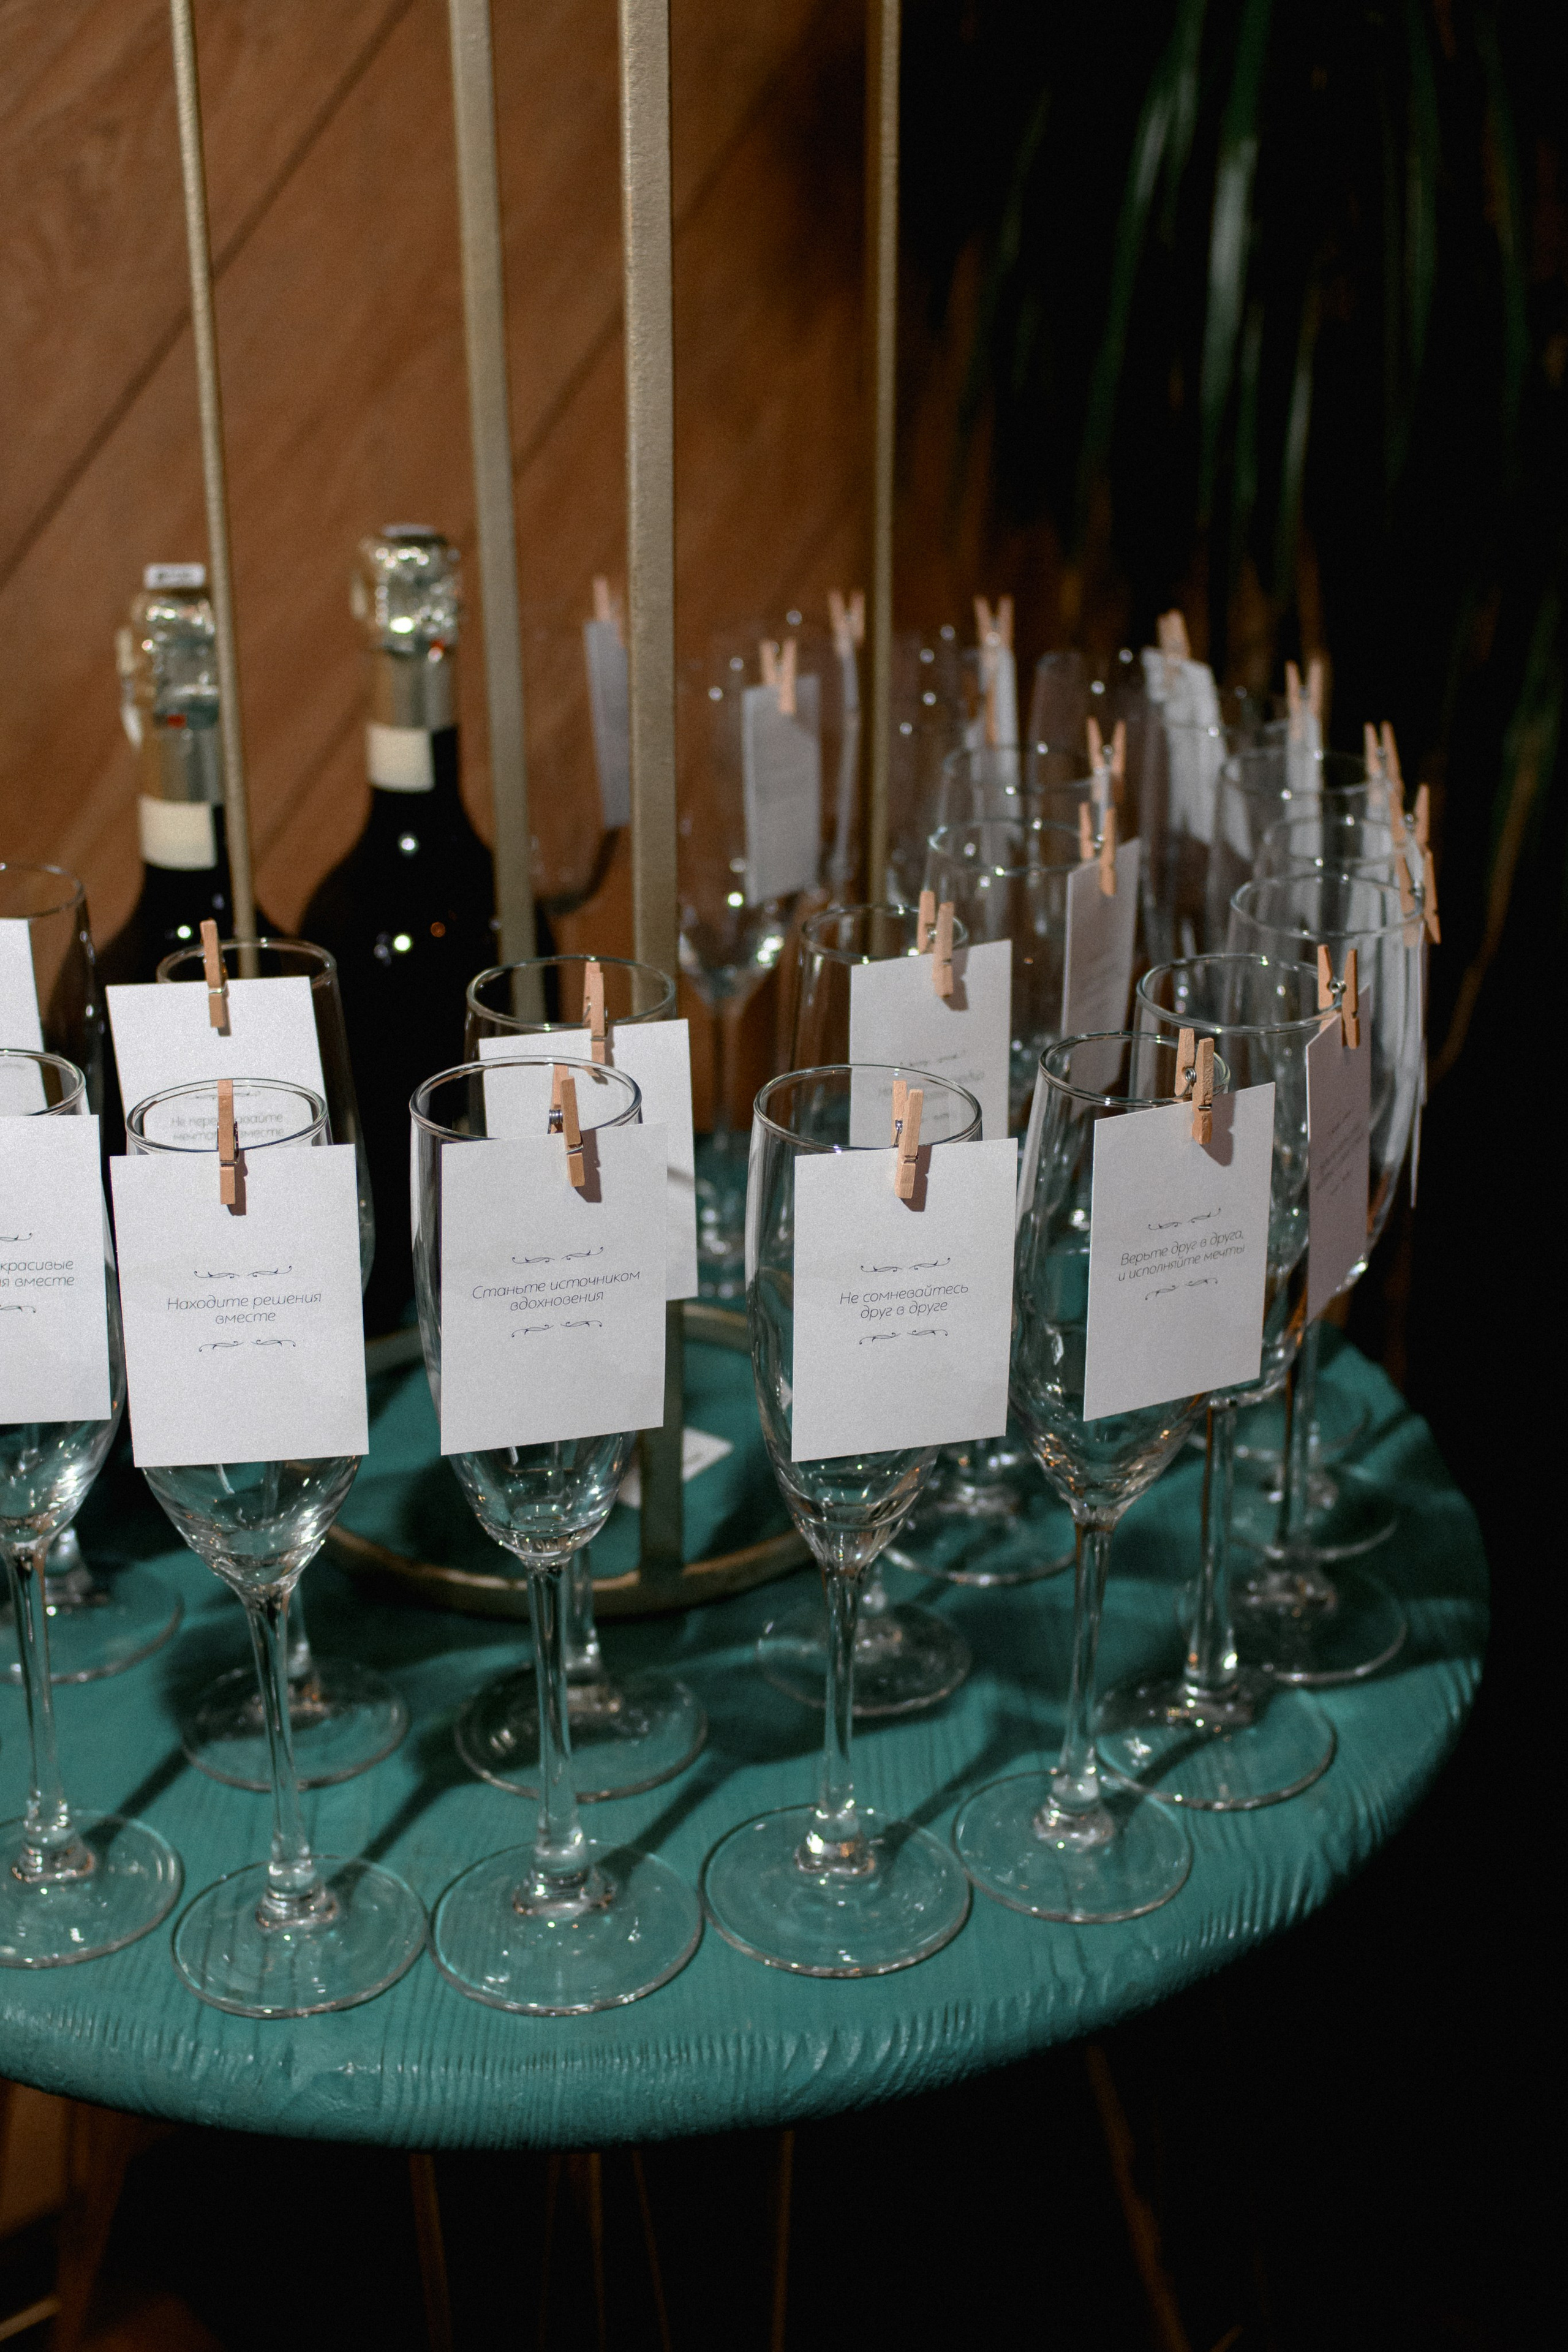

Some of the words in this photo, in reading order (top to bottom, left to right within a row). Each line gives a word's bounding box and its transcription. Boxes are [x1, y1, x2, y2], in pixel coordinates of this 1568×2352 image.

[189, 1112, 284, 1128] переавайте
[1121, 1248, 1168, 1266] Верьте
[1170, 1241, 1197, 1255] друг
[1200, 1238, 1207, 1248] в
[0, 1261, 74, 1274] красивые
[1118, 1272, 1125, 1281] и
[1129, 1254, 1201, 1280] исполняйте
[1204, 1245, 1245, 1262] мечты
[15, 1276, 75, 1287] вместе
[472, 1281, 546, 1299] Станьте
[550, 1272, 640, 1291] источником
[167, 1294, 249, 1310] Находите
[252, 1293, 322, 1310] решения
[510, 1291, 604, 1311] вдохновения
[840, 1291, 859, 1305] Не
[862, 1284, 969, 1303] сомневайтесь
[215, 1312, 276, 1325] вместе
[860, 1305, 892, 1321] друг
[896, 1306, 905, 1315] в
[909, 1300, 948, 1316] друге
